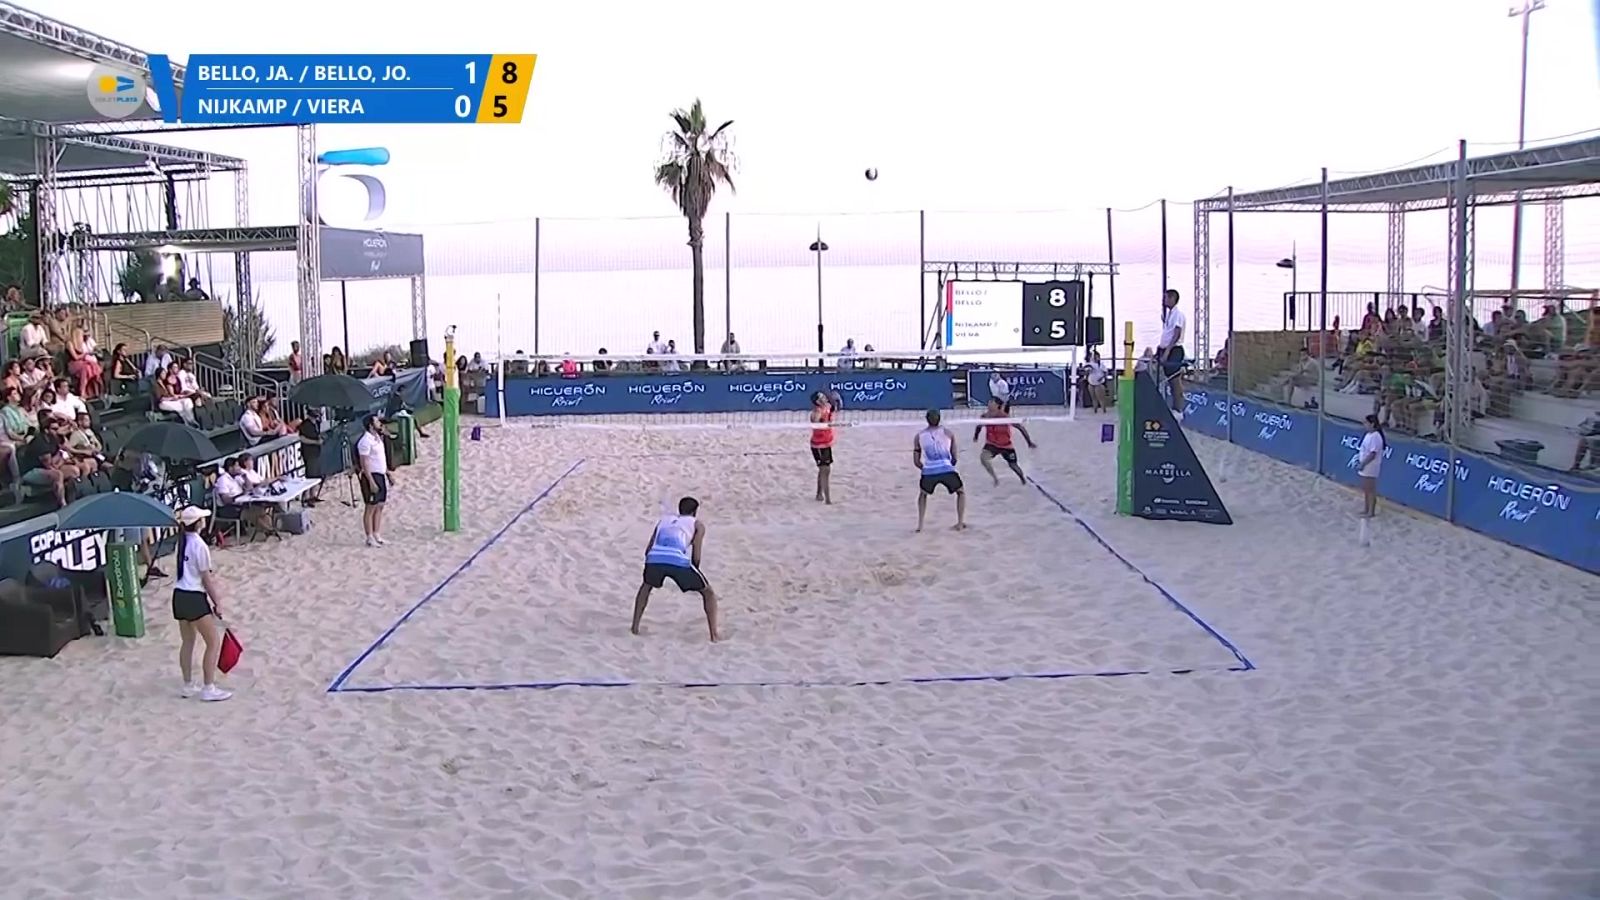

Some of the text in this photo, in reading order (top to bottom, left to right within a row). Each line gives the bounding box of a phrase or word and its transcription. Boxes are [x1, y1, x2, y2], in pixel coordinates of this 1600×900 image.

[1049, 288, 1066, 307] 8
[1050, 320, 1066, 339] 5
[530, 383, 606, 396] HIGUERÓN
[628, 381, 705, 394] HIGUERÓN
[729, 380, 806, 392] HIGUERÓN
[830, 378, 907, 390] HIGUERÓN
[1145, 469, 1192, 477] MARBELLA
[1487, 475, 1572, 511] HIGUERÓN
[31, 529, 63, 554] COPA
